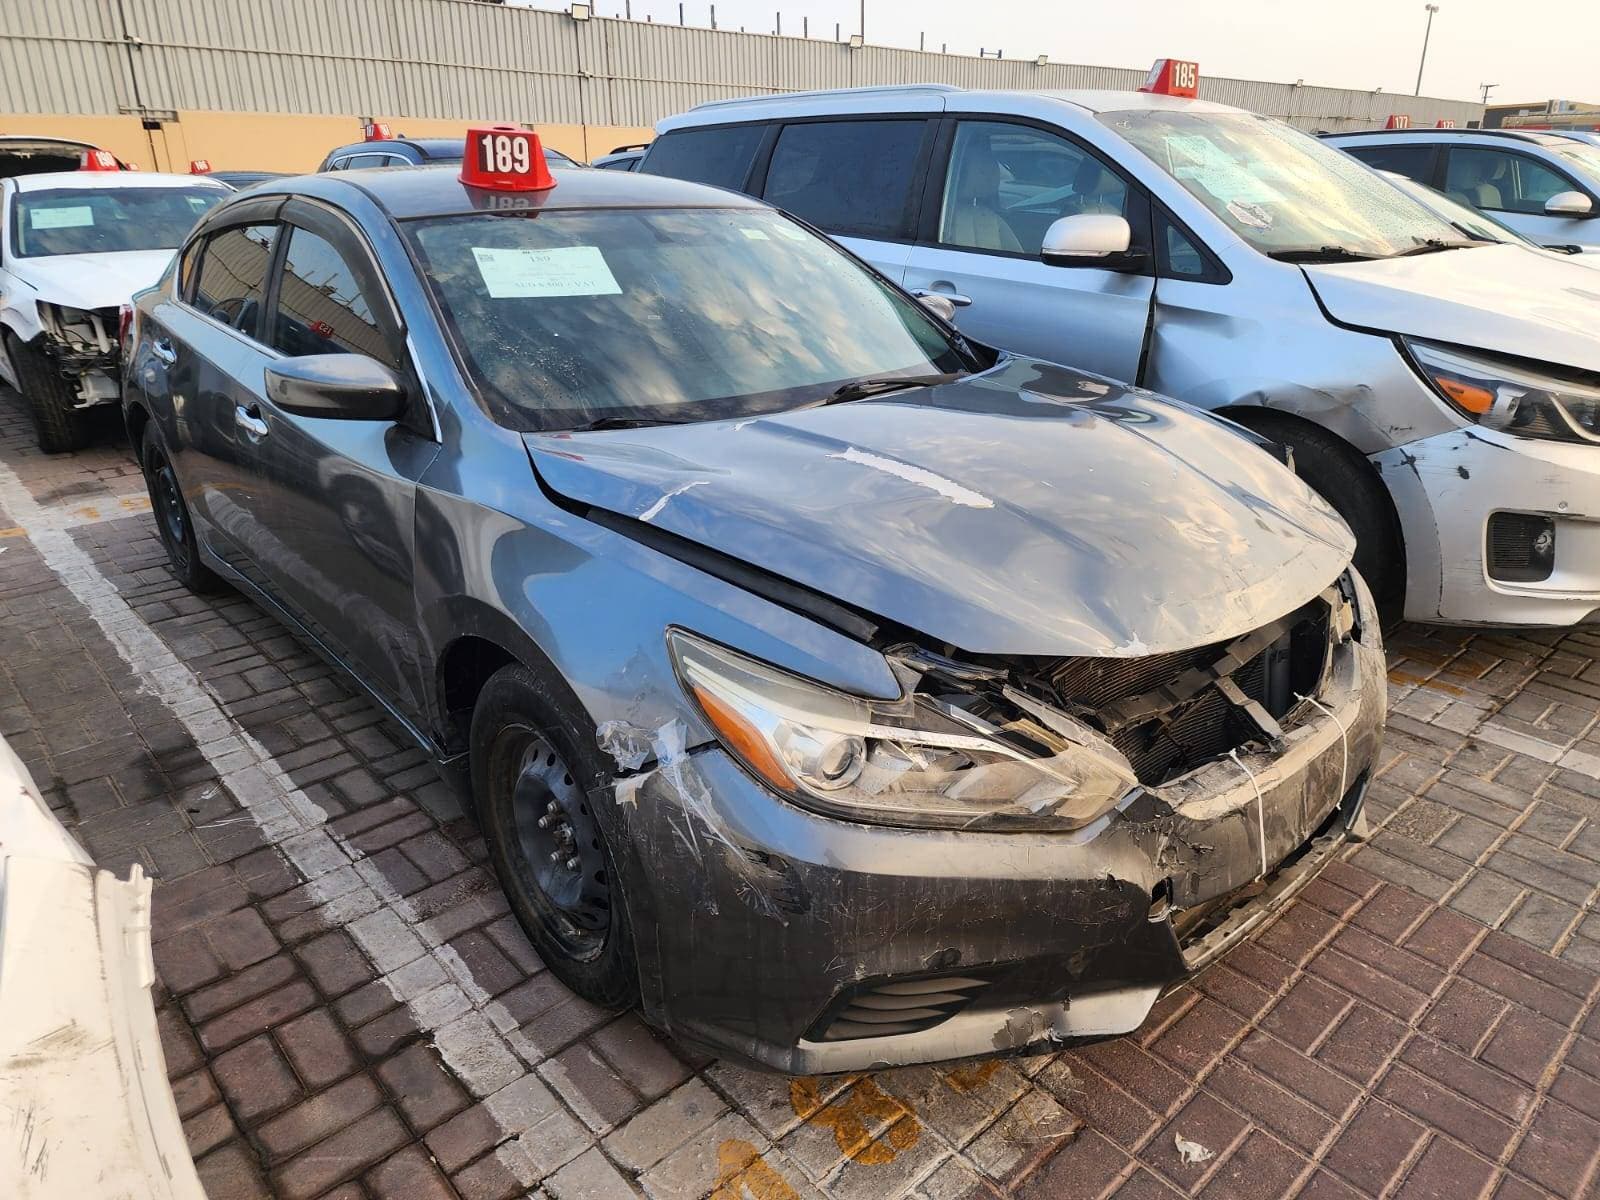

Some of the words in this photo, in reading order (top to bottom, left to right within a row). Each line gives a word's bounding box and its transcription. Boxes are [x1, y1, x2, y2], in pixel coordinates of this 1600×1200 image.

[1175, 62, 1195, 88] 185
[1394, 115, 1408, 129] 177
[482, 134, 530, 174] 189
